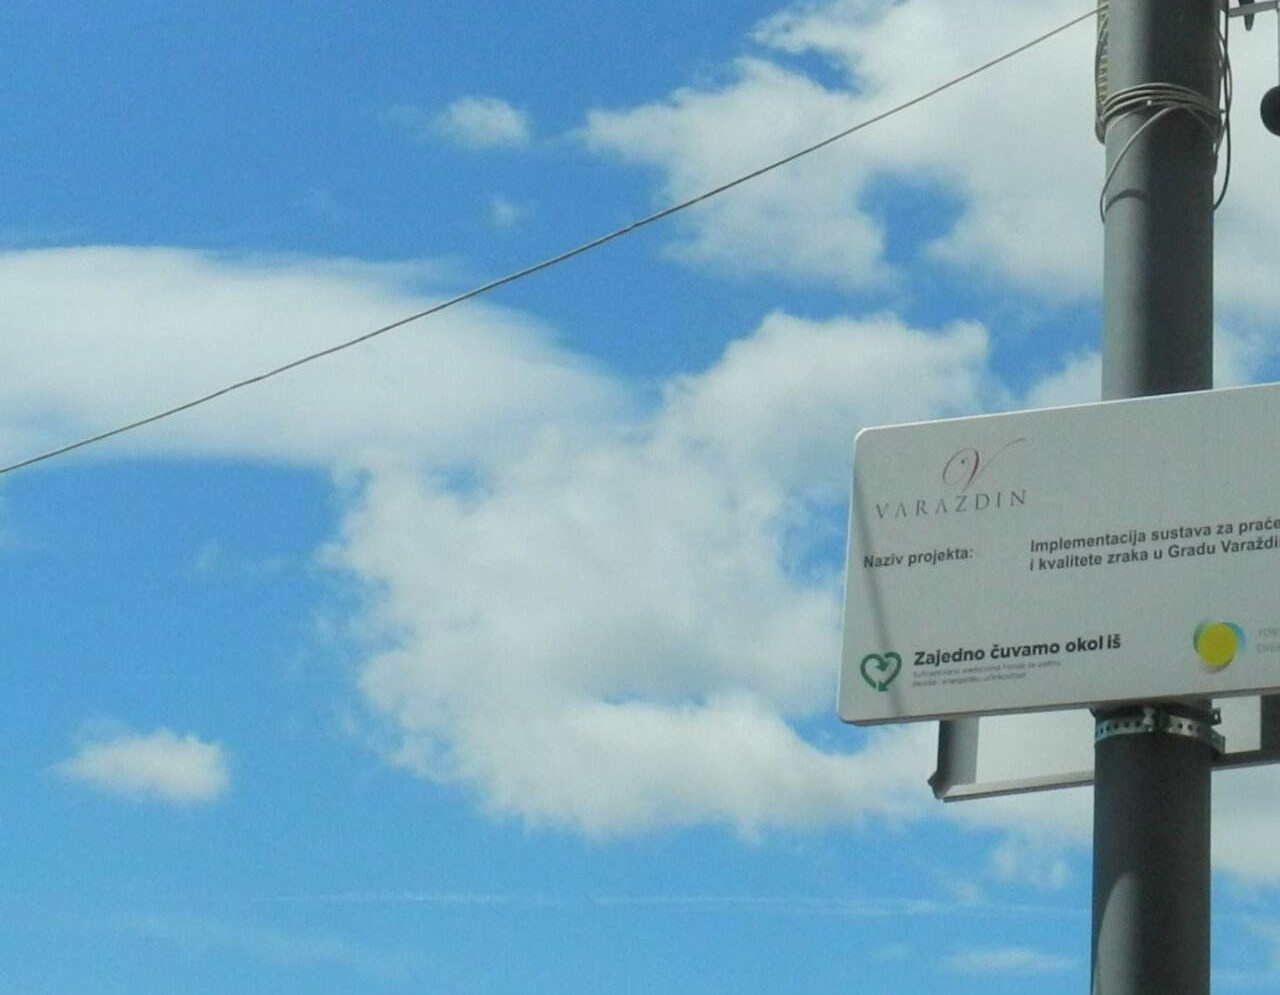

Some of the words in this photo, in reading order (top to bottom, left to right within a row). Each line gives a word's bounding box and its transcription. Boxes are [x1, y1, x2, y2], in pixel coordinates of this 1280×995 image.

[1030, 529, 1147, 554] Implementacija
[1151, 525, 1212, 542] sustava
[1216, 522, 1233, 535] za
[863, 553, 902, 569] Naziv
[908, 548, 974, 567] projekta:
[1029, 557, 1035, 572] i
[1038, 554, 1102, 571] kvalitete
[1106, 548, 1148, 565] zraka
[1153, 549, 1163, 560] u
[1167, 541, 1216, 559] Gradu
[913, 647, 985, 667] Zajedno
[990, 642, 1060, 660] čuvamo
